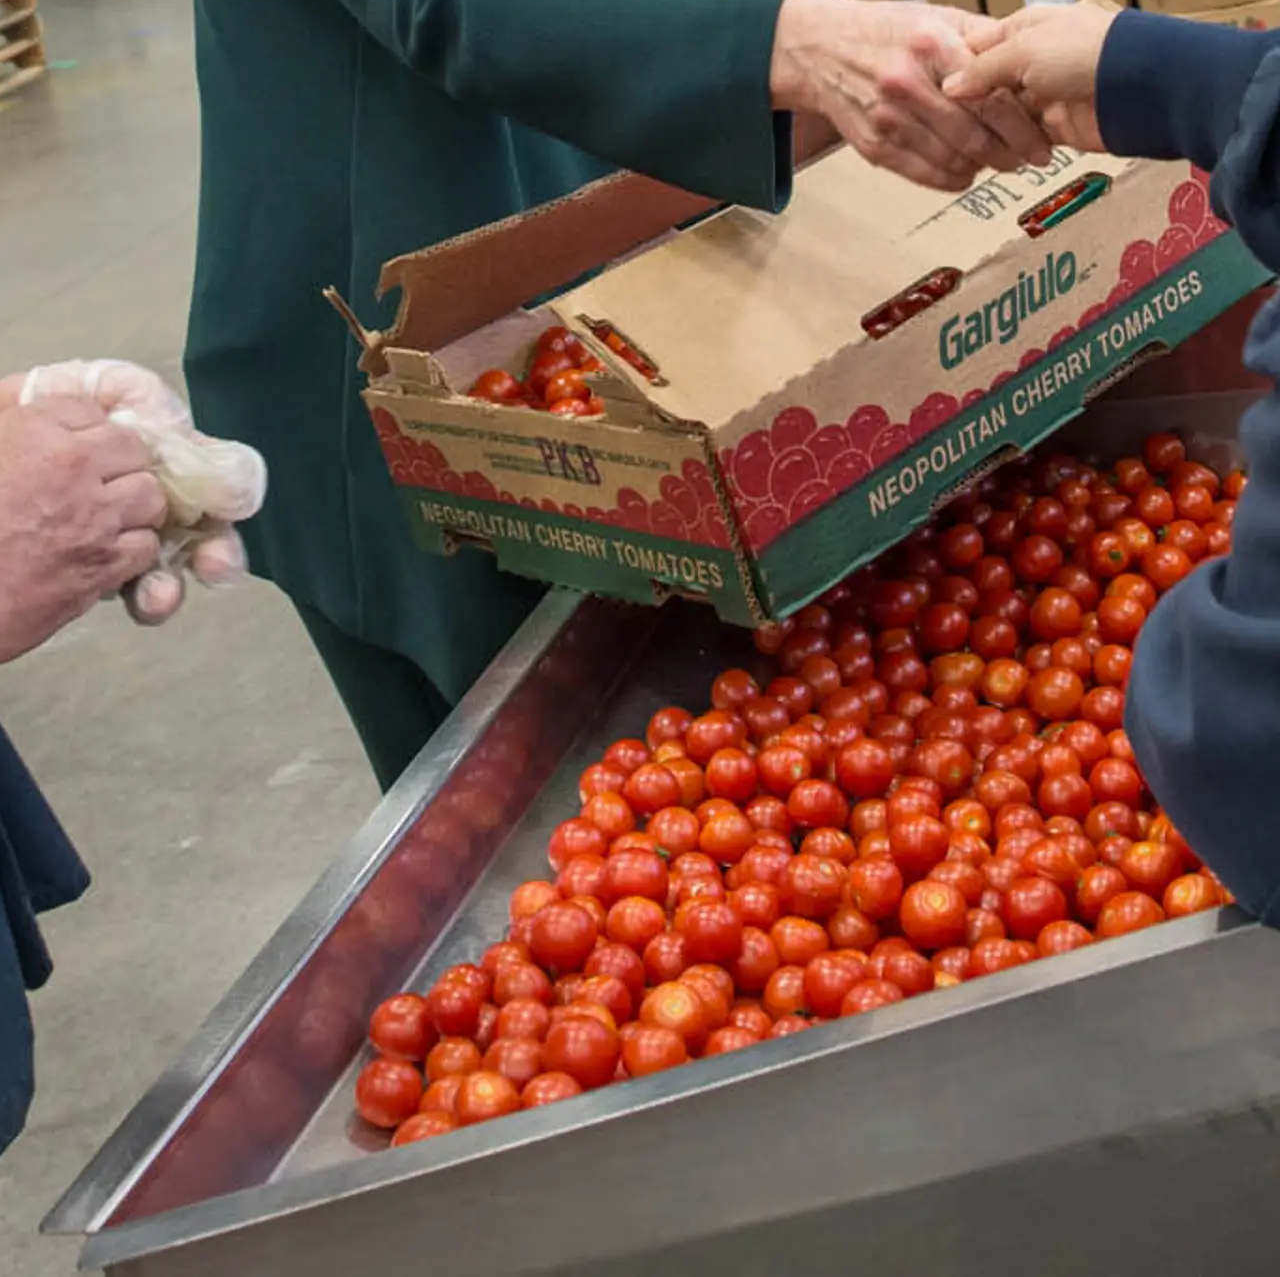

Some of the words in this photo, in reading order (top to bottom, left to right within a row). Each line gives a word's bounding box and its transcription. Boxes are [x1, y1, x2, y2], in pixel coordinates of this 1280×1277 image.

[938, 250, 1077, 371] Gargiulo
[867, 402, 1008, 519] NEOPOLITAN
[1011, 345, 1094, 417] CHERRY
[1097, 269, 1205, 358] TOMATOES
[536, 435, 603, 487] PKB
[420, 501, 533, 543] NEOPOLITAN
[535, 523, 608, 560] CHERRY
[612, 540, 725, 588] TOMATOES
